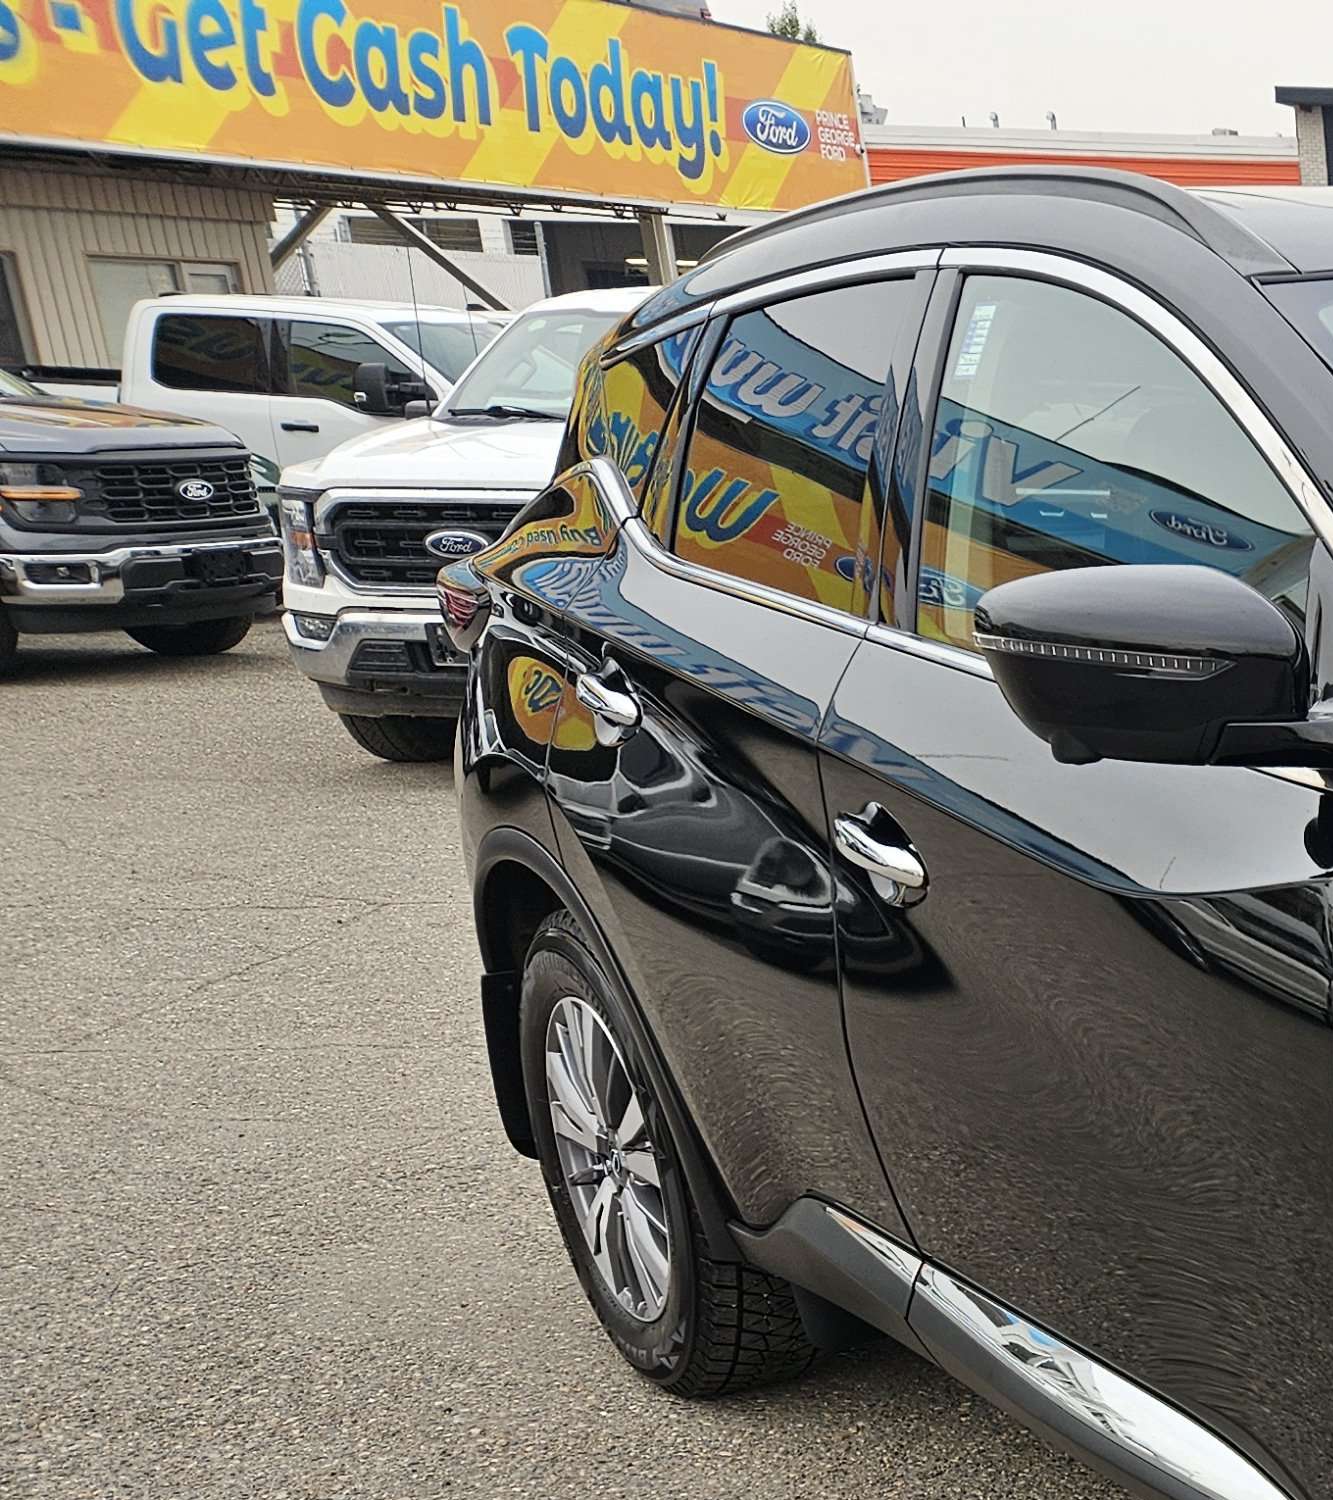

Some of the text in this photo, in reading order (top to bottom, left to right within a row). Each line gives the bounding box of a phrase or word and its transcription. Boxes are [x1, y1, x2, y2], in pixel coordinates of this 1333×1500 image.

[114, 0, 276, 97] Get
[297, 0, 492, 126] Cash
[504, 25, 722, 180] Today!
[756, 106, 798, 147] Ford
[815, 109, 849, 129] PRINCE
[817, 126, 856, 147] GEORGE
[820, 143, 846, 162] FORD
[187, 484, 207, 497] Ford
[439, 536, 473, 553] Ford
